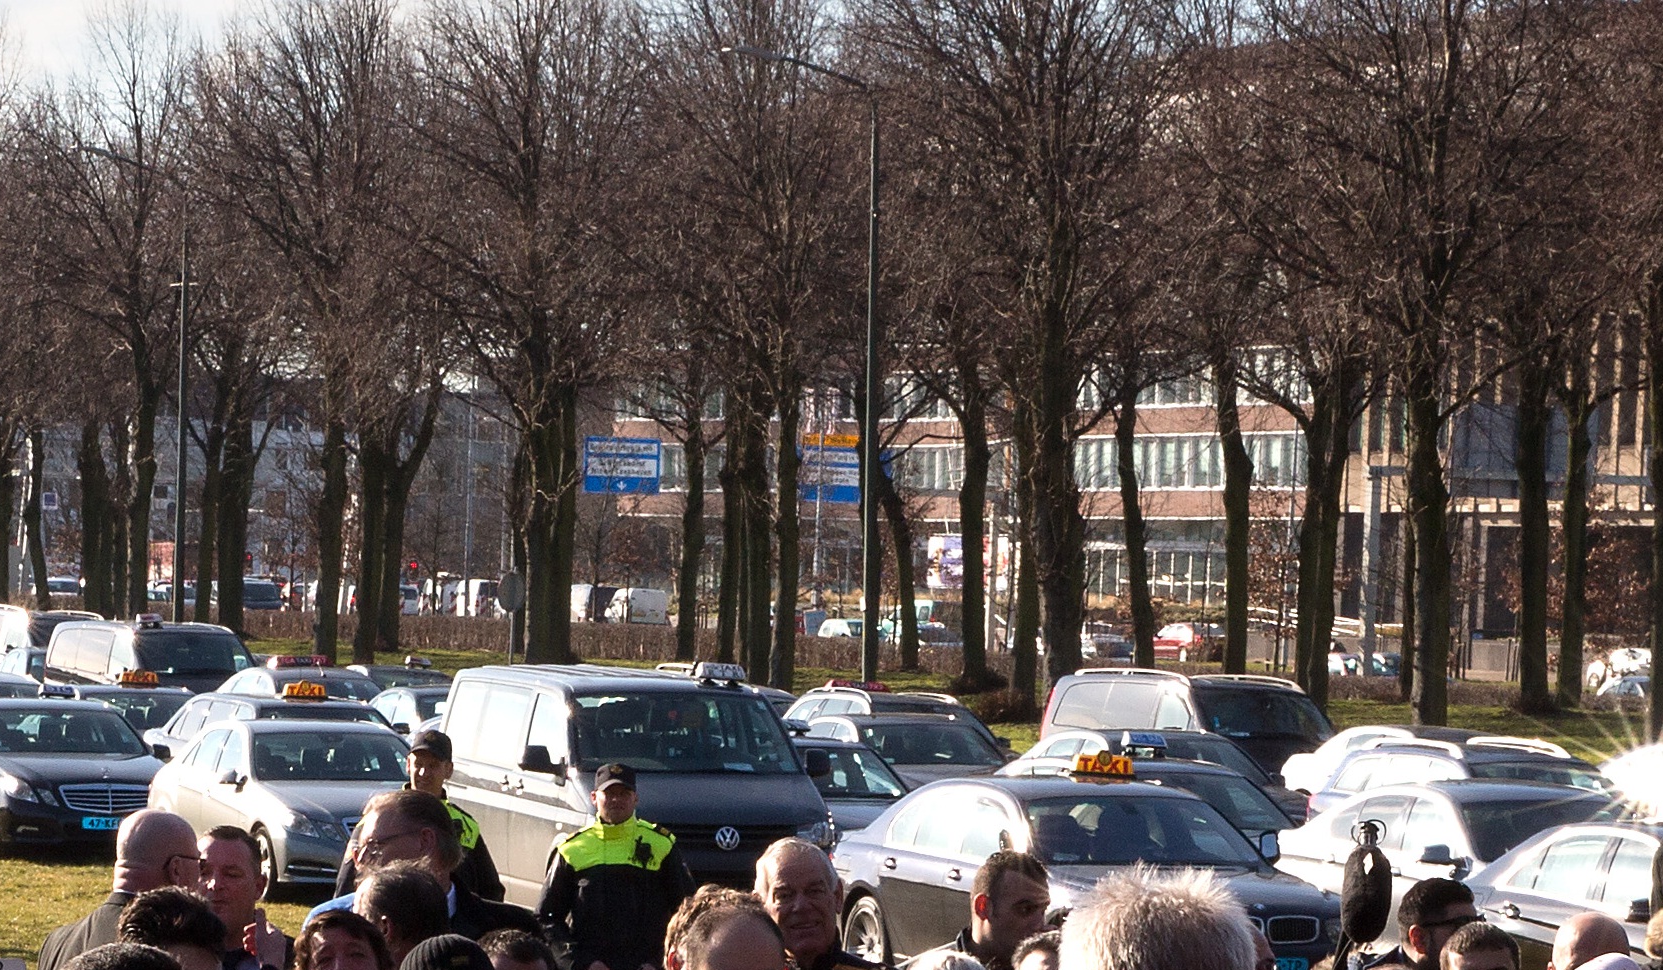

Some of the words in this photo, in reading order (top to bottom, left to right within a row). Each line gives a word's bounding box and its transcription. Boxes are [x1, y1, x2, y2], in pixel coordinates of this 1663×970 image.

[287, 685, 322, 697] TAXI
[1079, 757, 1129, 774] TAXI
[88, 818, 117, 828] 47-KF
